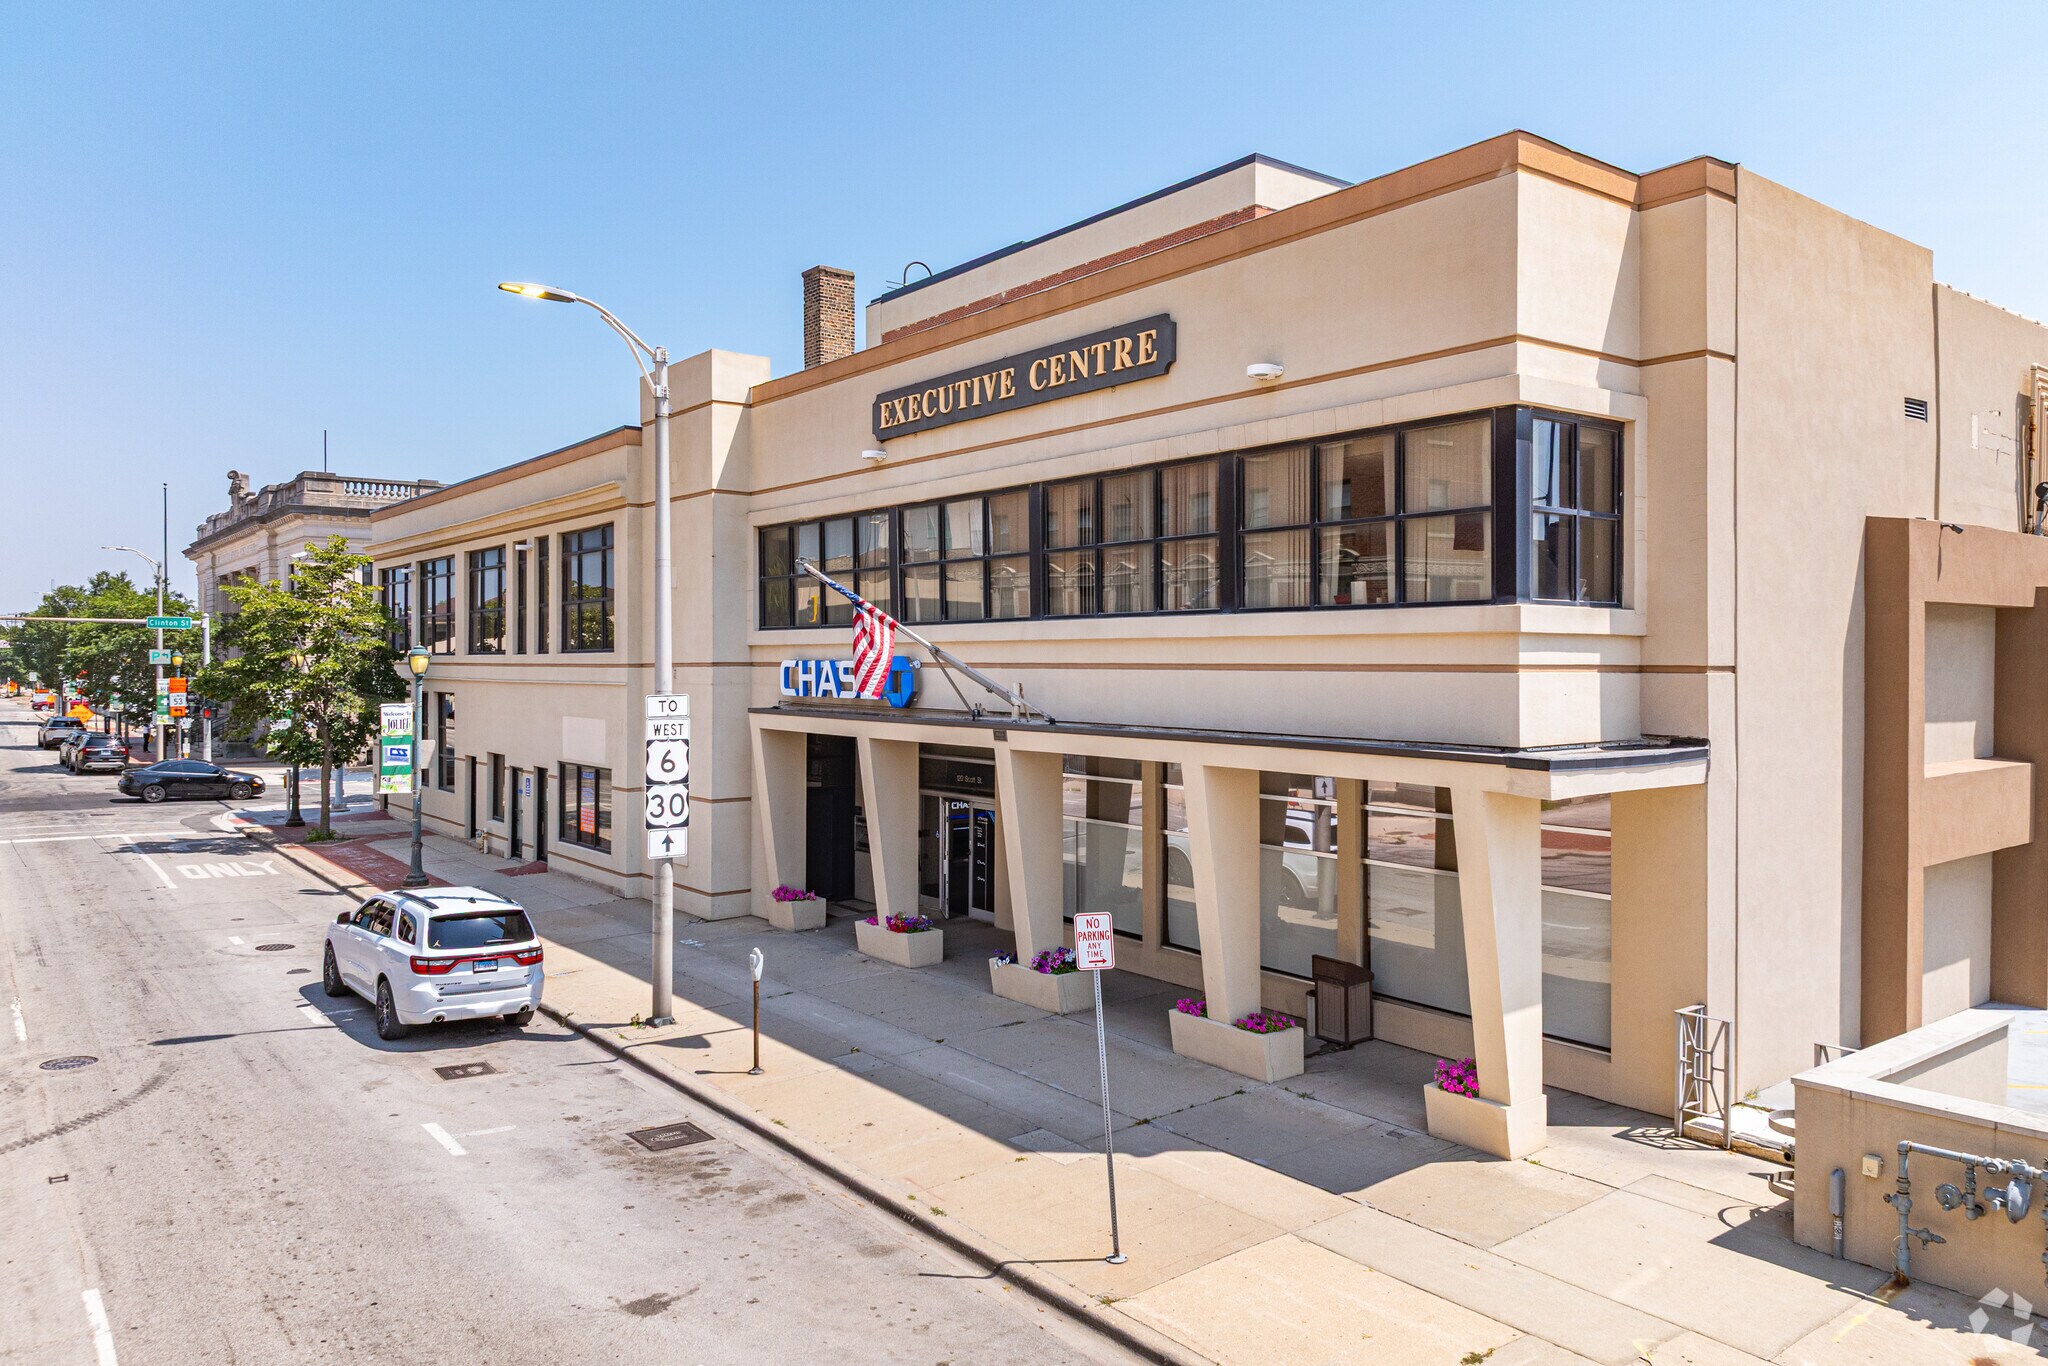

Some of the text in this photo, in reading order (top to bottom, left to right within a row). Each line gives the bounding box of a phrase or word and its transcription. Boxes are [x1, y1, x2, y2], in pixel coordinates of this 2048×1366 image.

[879, 328, 1158, 429] EXECUTIVE CENTRE
[151, 651, 161, 662] P
[780, 659, 869, 700] CHAS
[658, 700, 678, 713] TO
[384, 718, 410, 733] JOLIET
[653, 723, 684, 736] WEST
[660, 749, 676, 773] 6
[649, 793, 685, 819] 30
[951, 802, 970, 810] CHA
[176, 860, 281, 880] ONLY
[1085, 918, 1100, 929] NO
[1078, 930, 1110, 942] PARKING
[1087, 942, 1102, 950] ANY
[1086, 949, 1104, 958] TIME
